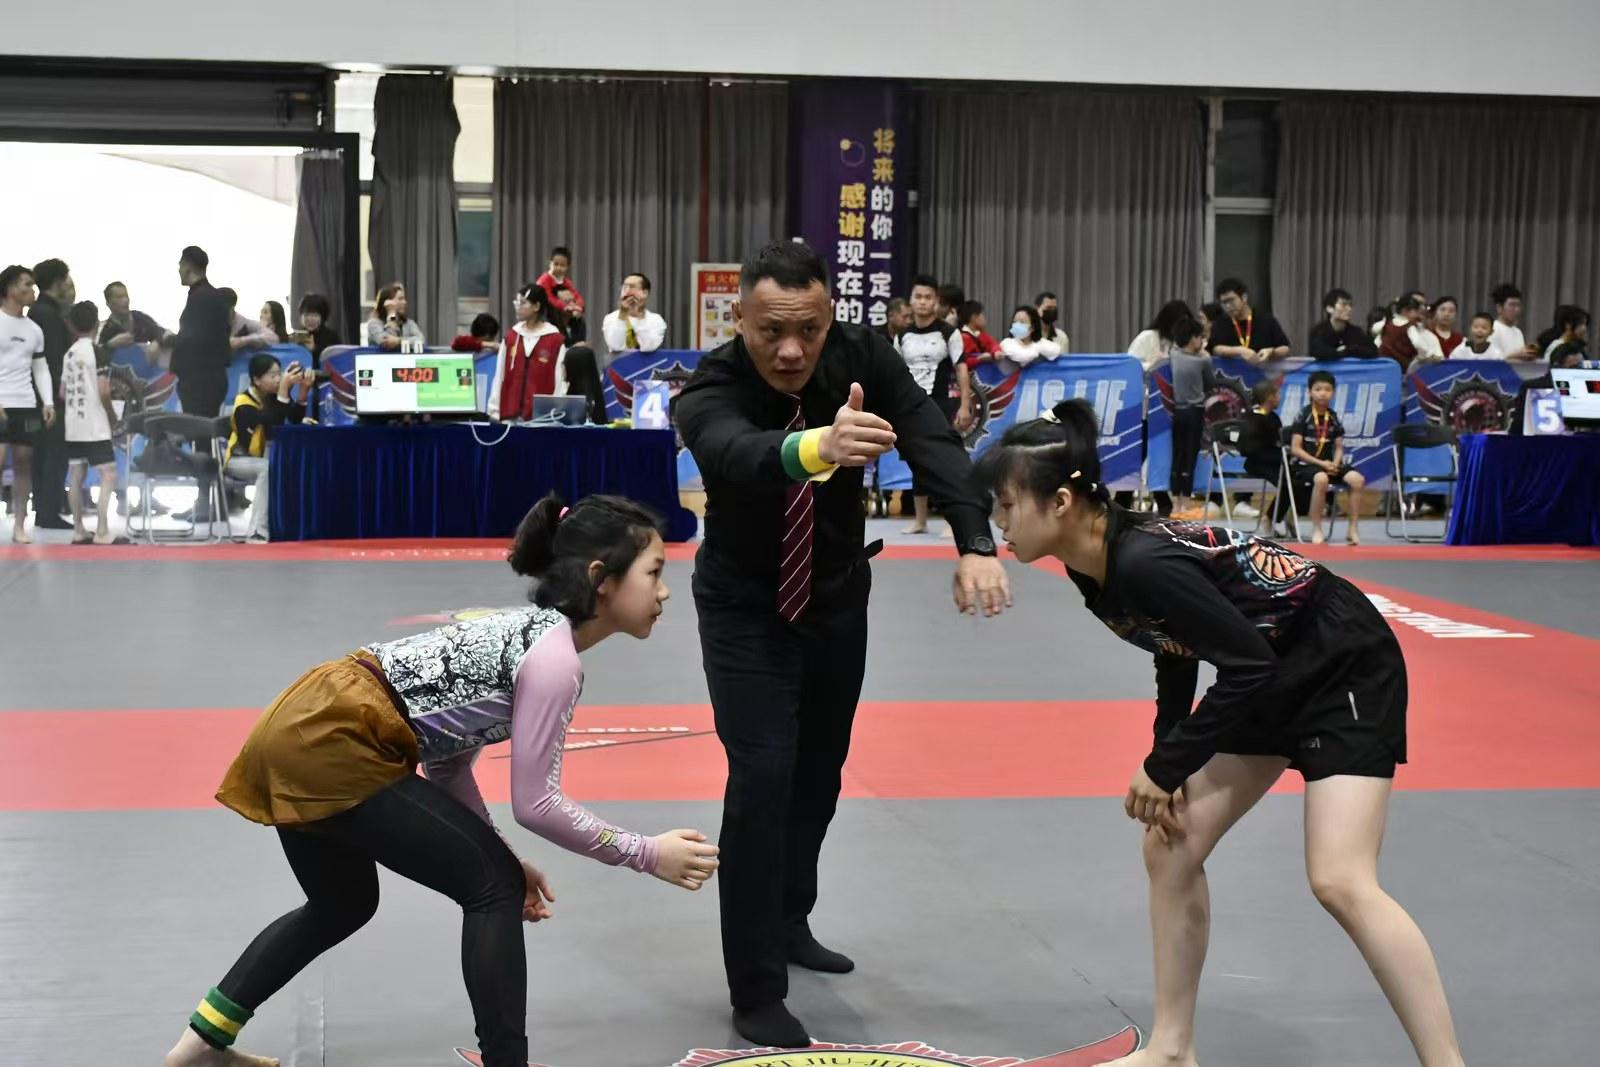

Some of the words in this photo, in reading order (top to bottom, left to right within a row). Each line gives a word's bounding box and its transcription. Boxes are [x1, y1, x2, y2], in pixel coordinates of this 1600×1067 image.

[868, 128, 895, 326] 将来的你一定会
[835, 182, 866, 324] 感谢现在的
[397, 368, 434, 382] 4:00
[639, 392, 666, 427] 4
[1538, 399, 1561, 432] 5
